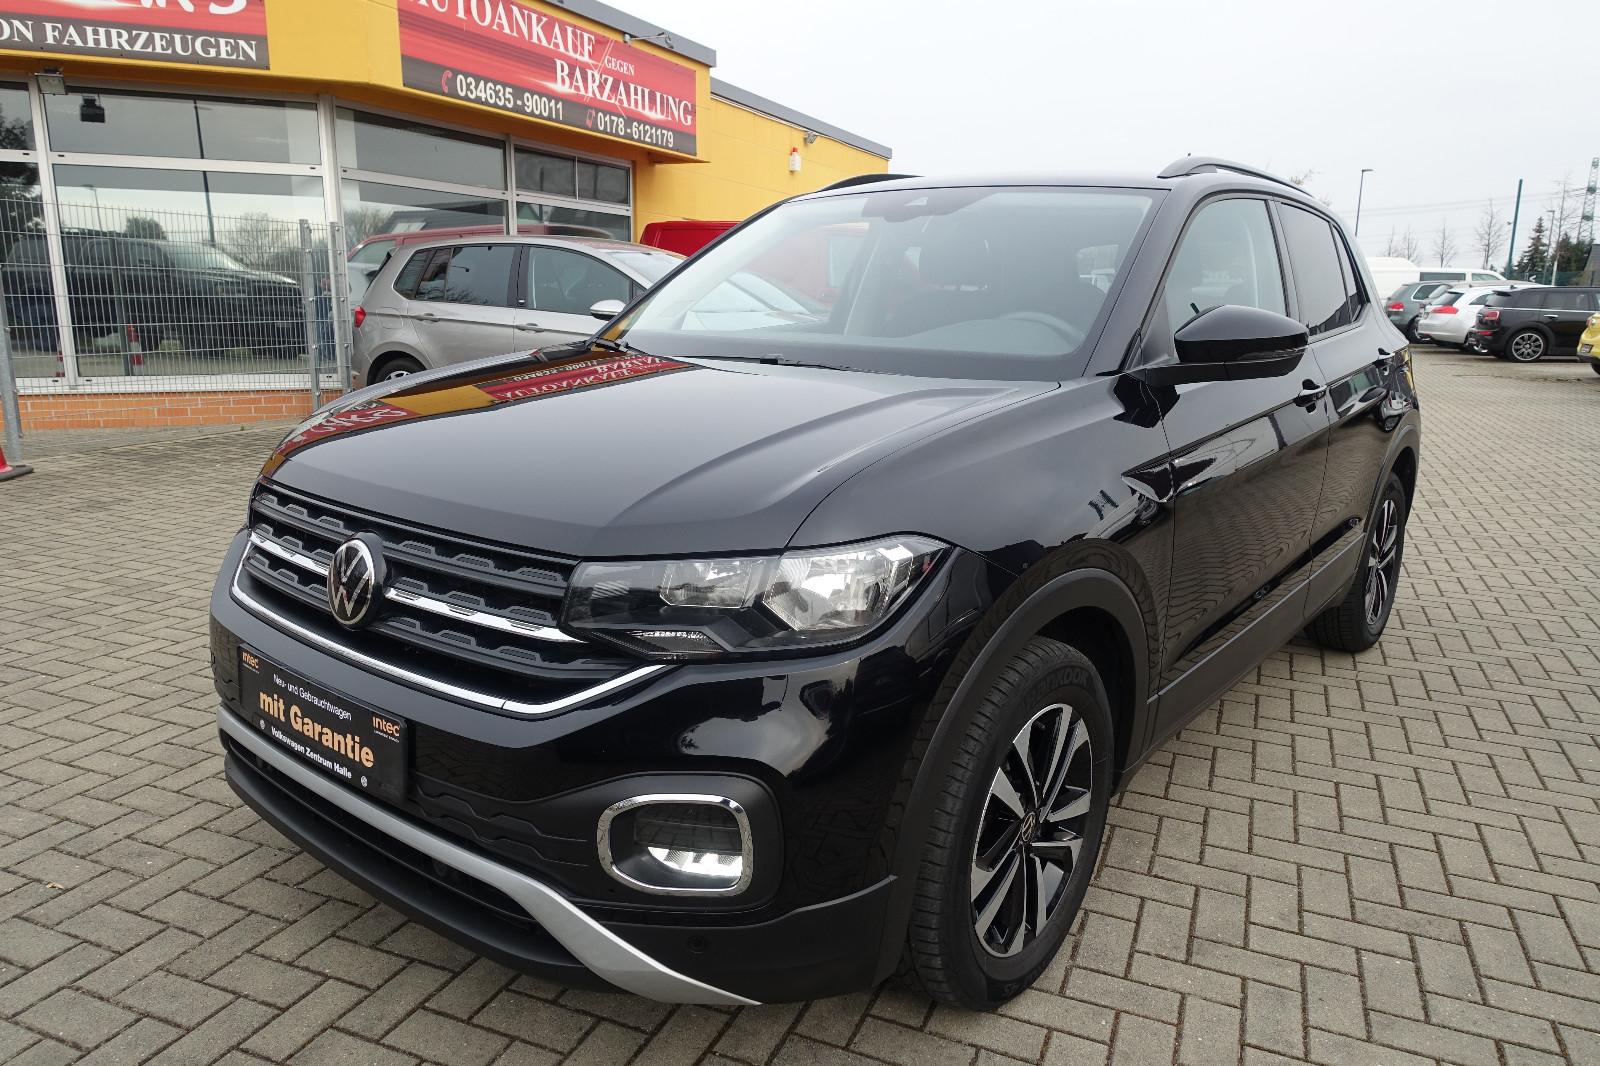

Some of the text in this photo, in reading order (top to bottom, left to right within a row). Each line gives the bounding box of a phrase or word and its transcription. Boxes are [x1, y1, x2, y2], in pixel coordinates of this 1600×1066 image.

[42, 21, 257, 62] FAHRZEUGEN
[408, 0, 595, 63] TOANKAUF
[554, 58, 692, 126] BARZAHLUNG
[604, 55, 635, 76] GEGEN
[287, 682, 299, 695] und
[259, 691, 375, 768] mit Garantie
[271, 726, 352, 779] Volkswagen Zentrum Halle
